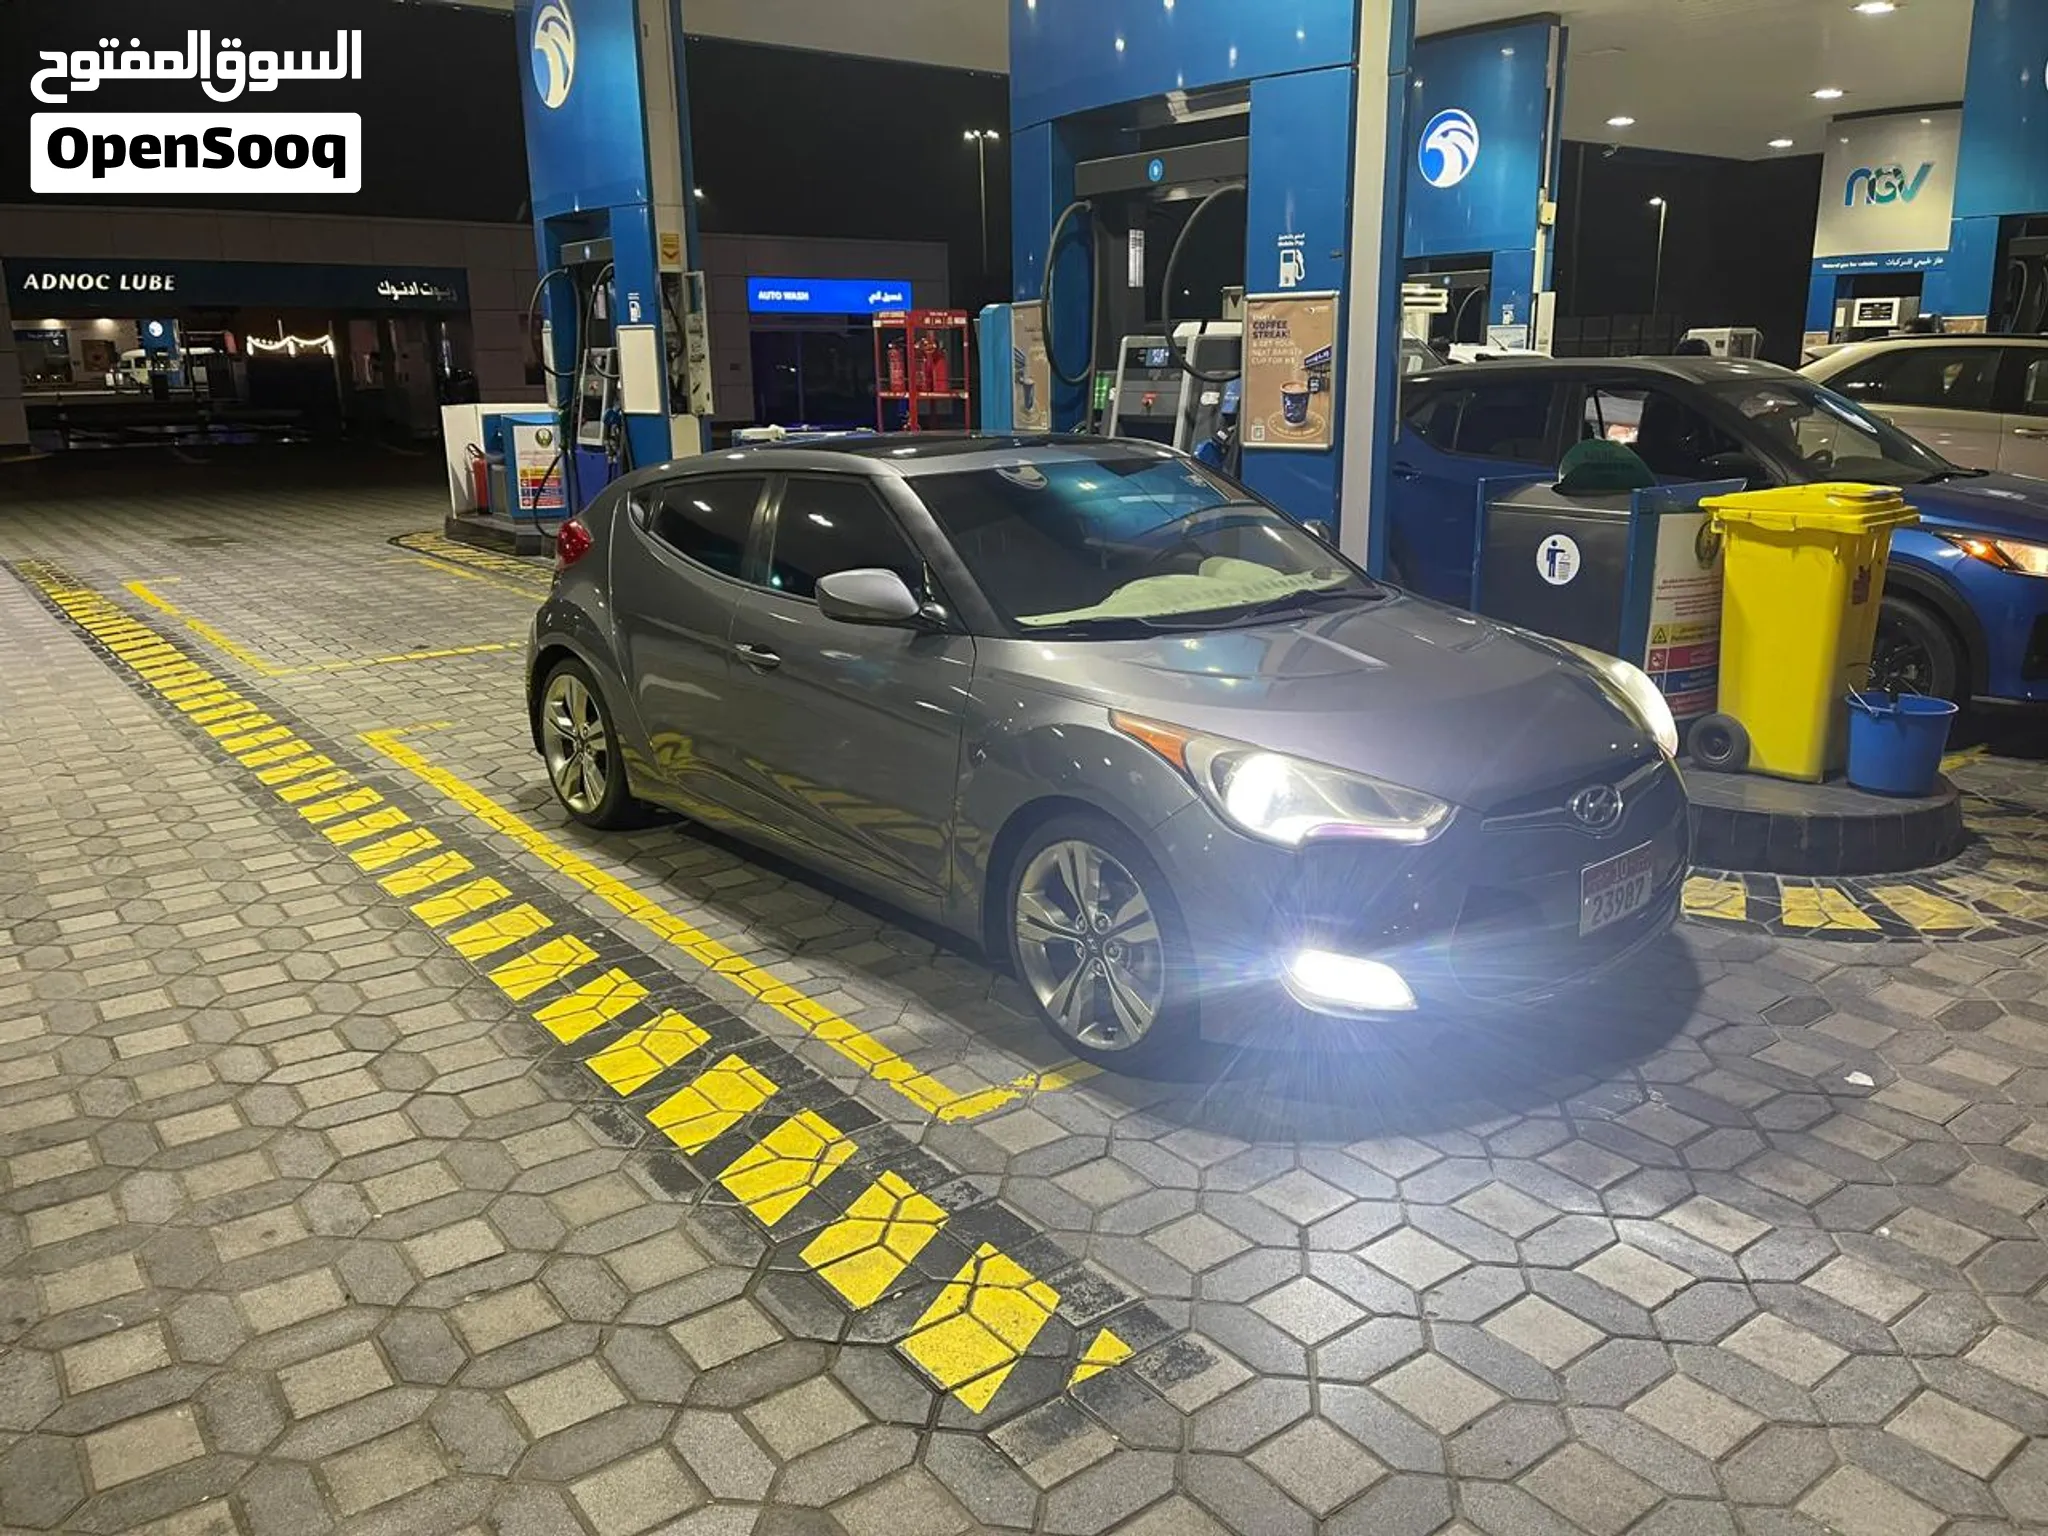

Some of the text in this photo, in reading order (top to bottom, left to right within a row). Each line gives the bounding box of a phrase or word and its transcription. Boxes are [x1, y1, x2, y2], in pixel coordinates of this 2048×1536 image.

[23, 273, 175, 291] ADNOC LUBE
[758, 290, 809, 301] AUTO WASH
[1252, 320, 1288, 329] COFFEE
[1252, 330, 1291, 339] STREAK!
[1251, 347, 1303, 356] NEXT BARISTA
[1251, 357, 1267, 365] CUP
[1614, 858, 1628, 882] 10
[1590, 876, 1645, 927] 23987
